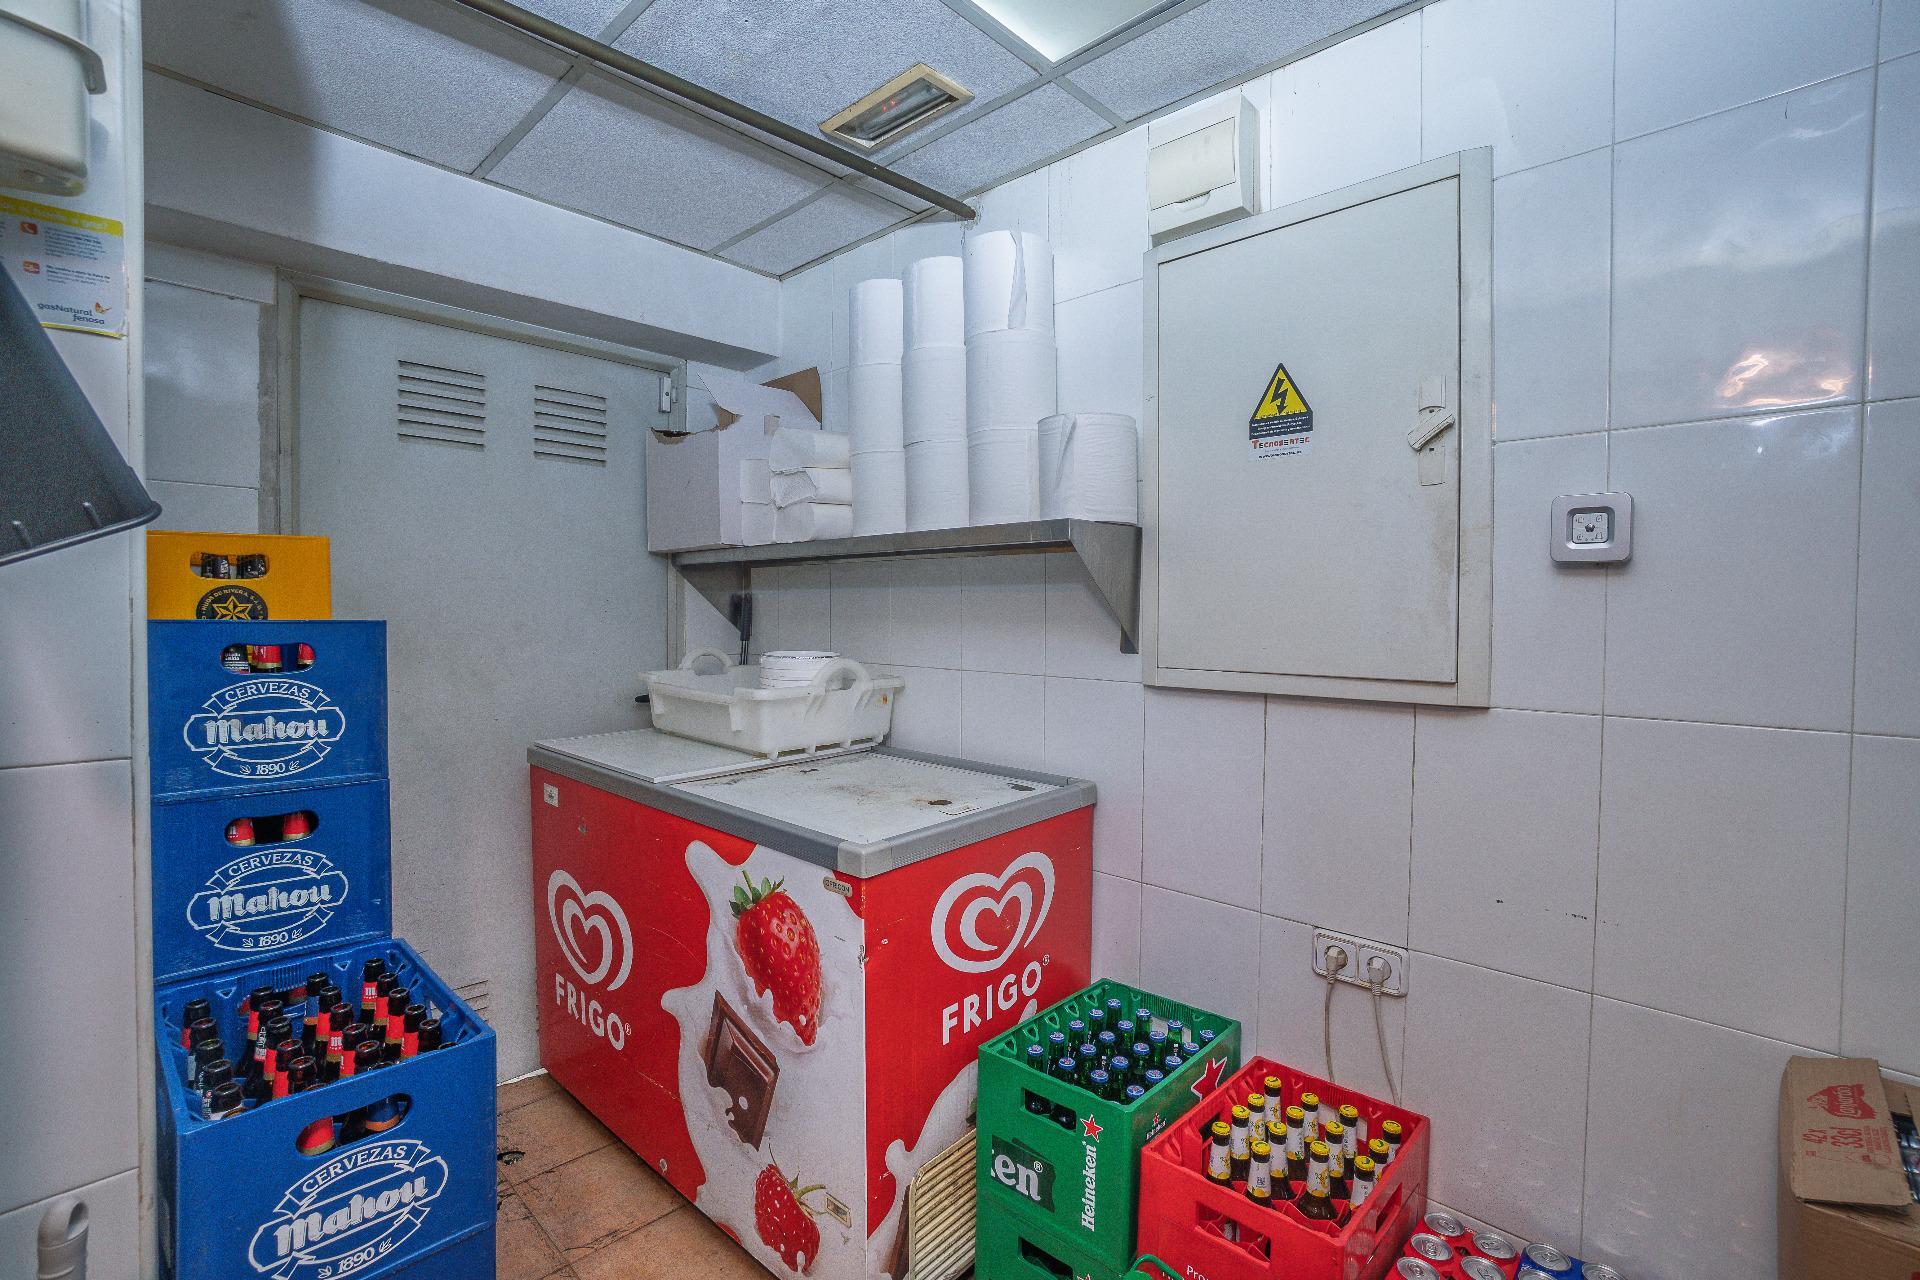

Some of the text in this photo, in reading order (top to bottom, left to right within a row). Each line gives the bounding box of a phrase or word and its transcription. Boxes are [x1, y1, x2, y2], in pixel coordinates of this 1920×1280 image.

[37, 302, 93, 316] gasNatural
[73, 314, 105, 325] fenosa
[225, 682, 310, 702] CERVEZAS
[203, 715, 329, 744] Mahou
[255, 762, 286, 775] 1890
[228, 853, 314, 876] CERVEZAS
[206, 885, 333, 921] Mahou
[258, 931, 289, 947] 1890
[302, 1145, 408, 1193] CERVEZAS
[1081, 1143, 1097, 1232] Heineken
[273, 1175, 429, 1257] Mahou
[337, 1247, 375, 1275] 1890
